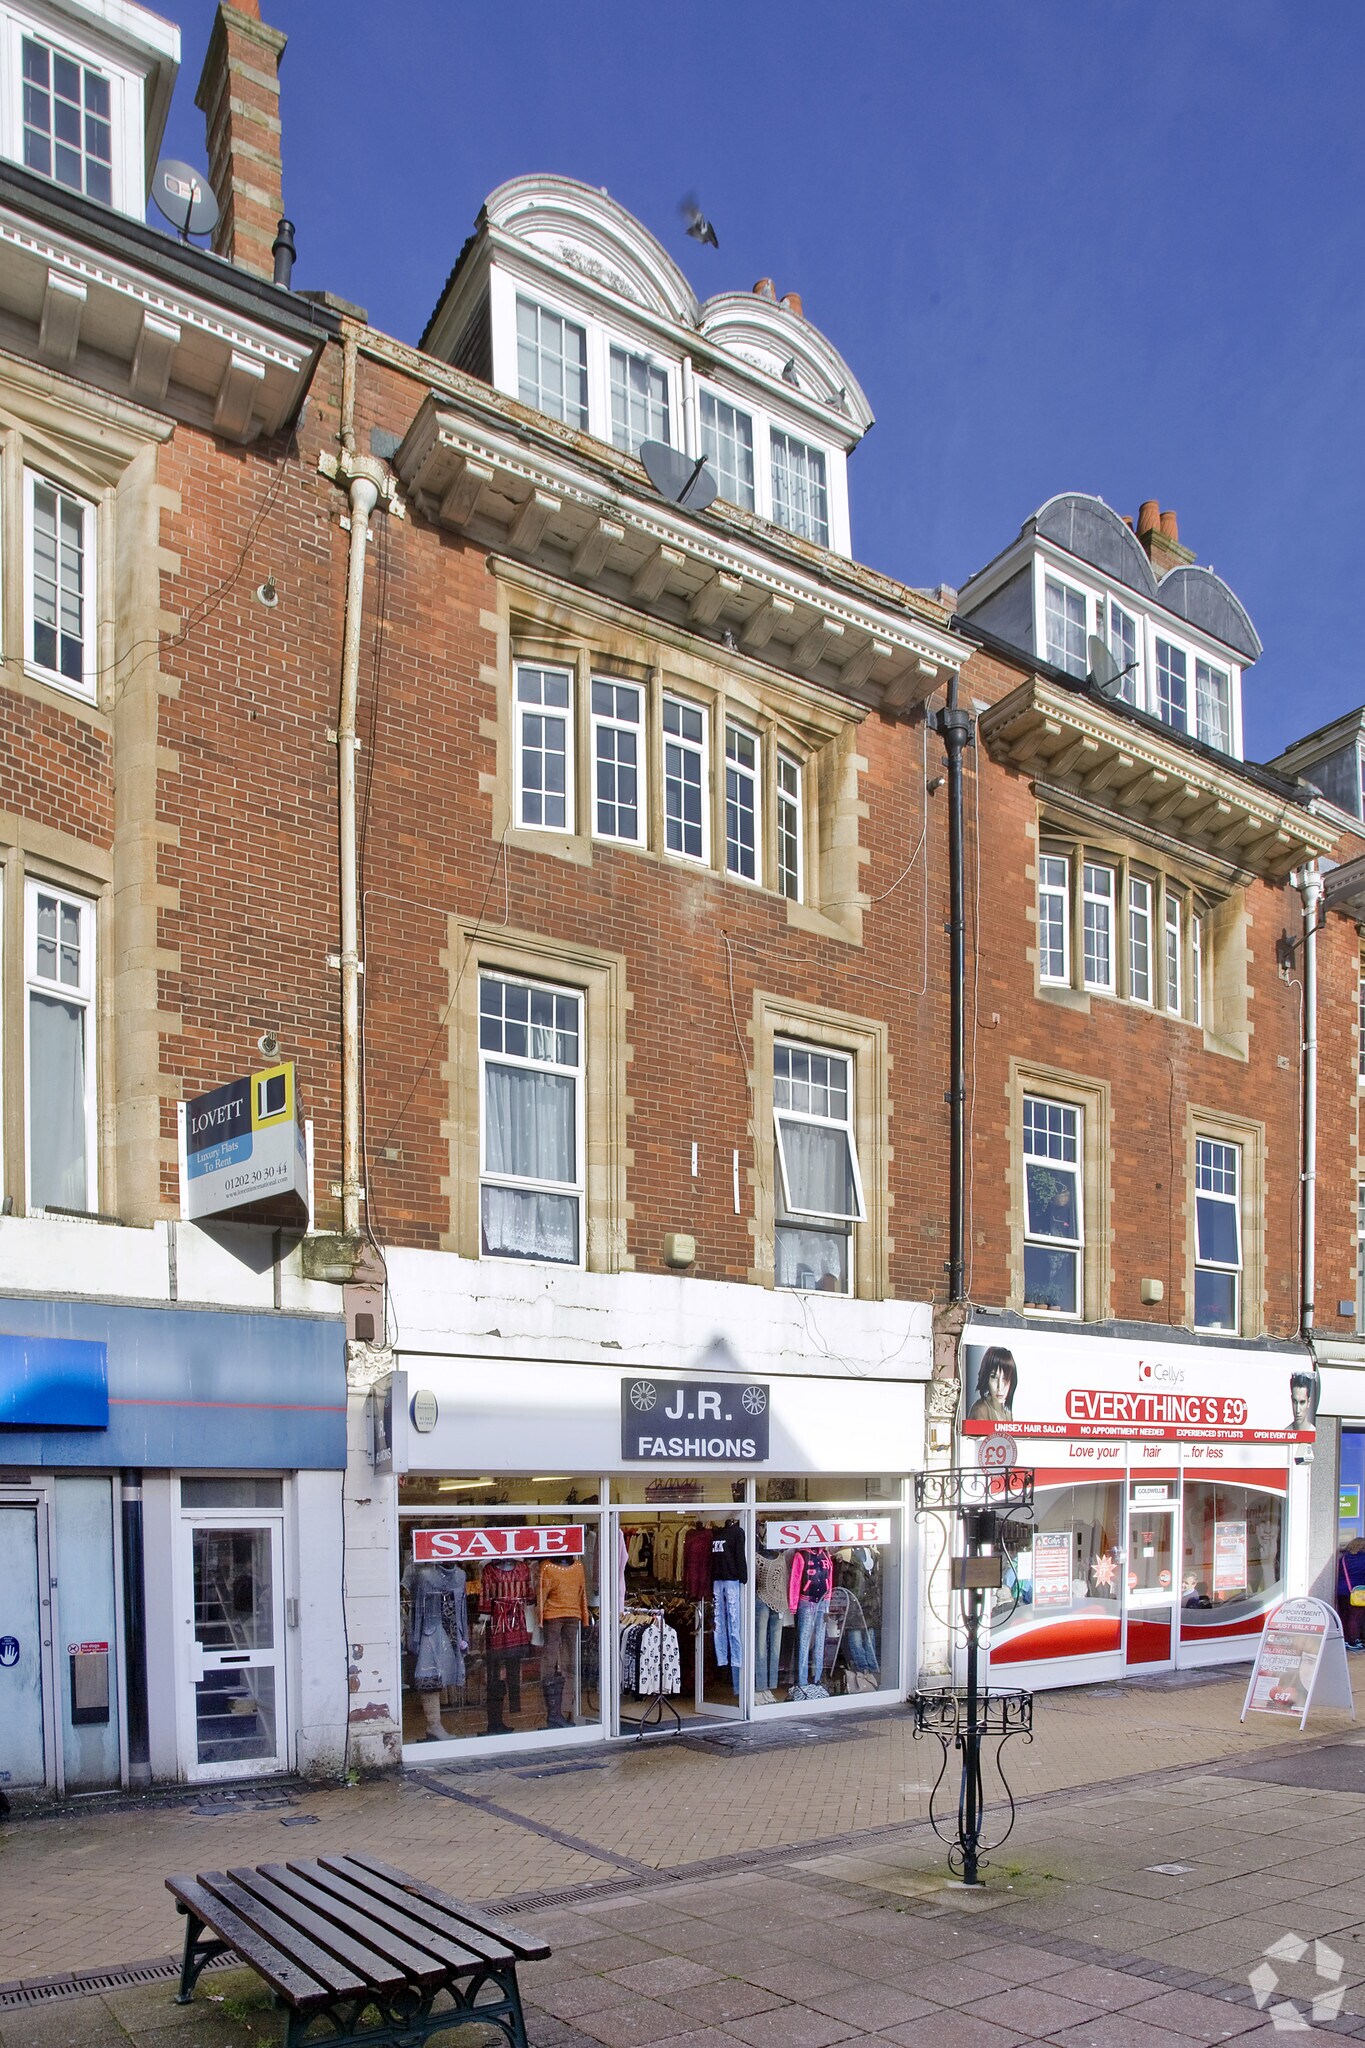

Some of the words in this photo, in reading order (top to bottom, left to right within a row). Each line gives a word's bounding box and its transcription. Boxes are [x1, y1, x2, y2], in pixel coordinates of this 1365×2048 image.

[191, 1098, 244, 1135] LOVETT
[197, 1149, 220, 1163] Luxury
[221, 1142, 239, 1154] Flats
[204, 1162, 214, 1173] To
[215, 1156, 232, 1169] Rent
[225, 1174, 249, 1190] 01202
[251, 1170, 262, 1184] 30
[264, 1166, 275, 1180] 30
[276, 1161, 288, 1175] 44
[1154, 1364, 1185, 1385] Celly's
[664, 1389, 732, 1421] J.R.
[994, 1423, 1023, 1433] UNISEX
[1023, 1424, 1043, 1433] HAIR
[1043, 1424, 1067, 1434] SALON
[1080, 1426, 1091, 1434] NO
[1092, 1426, 1139, 1435] APPOINTMENT
[1139, 1428, 1165, 1436] NEEDED
[1176, 1428, 1216, 1438] EXPERIENCED
[1217, 1430, 1244, 1438] STYLISTS
[1254, 1431, 1270, 1439] OPEN
[1287, 1432, 1298, 1440] DAY
[638, 1437, 756, 1458] FASHIONS
[1069, 1443, 1095, 1458] Love
[1096, 1446, 1120, 1461] your
[1143, 1444, 1162, 1458] hair
[1191, 1445, 1205, 1458] for
[1206, 1445, 1224, 1458] less
[779, 1521, 879, 1545] SALE
[431, 1529, 569, 1557] SALE
[1280, 1607, 1322, 1617] APPOINTMENT
[1285, 1615, 1311, 1623] NEEDED
[1263, 1647, 1297, 1655] VALENTINES
[1261, 1655, 1302, 1666] highlight
[1260, 1665, 1288, 1673] SPECIAL
[1274, 1692, 1291, 1701] £47
